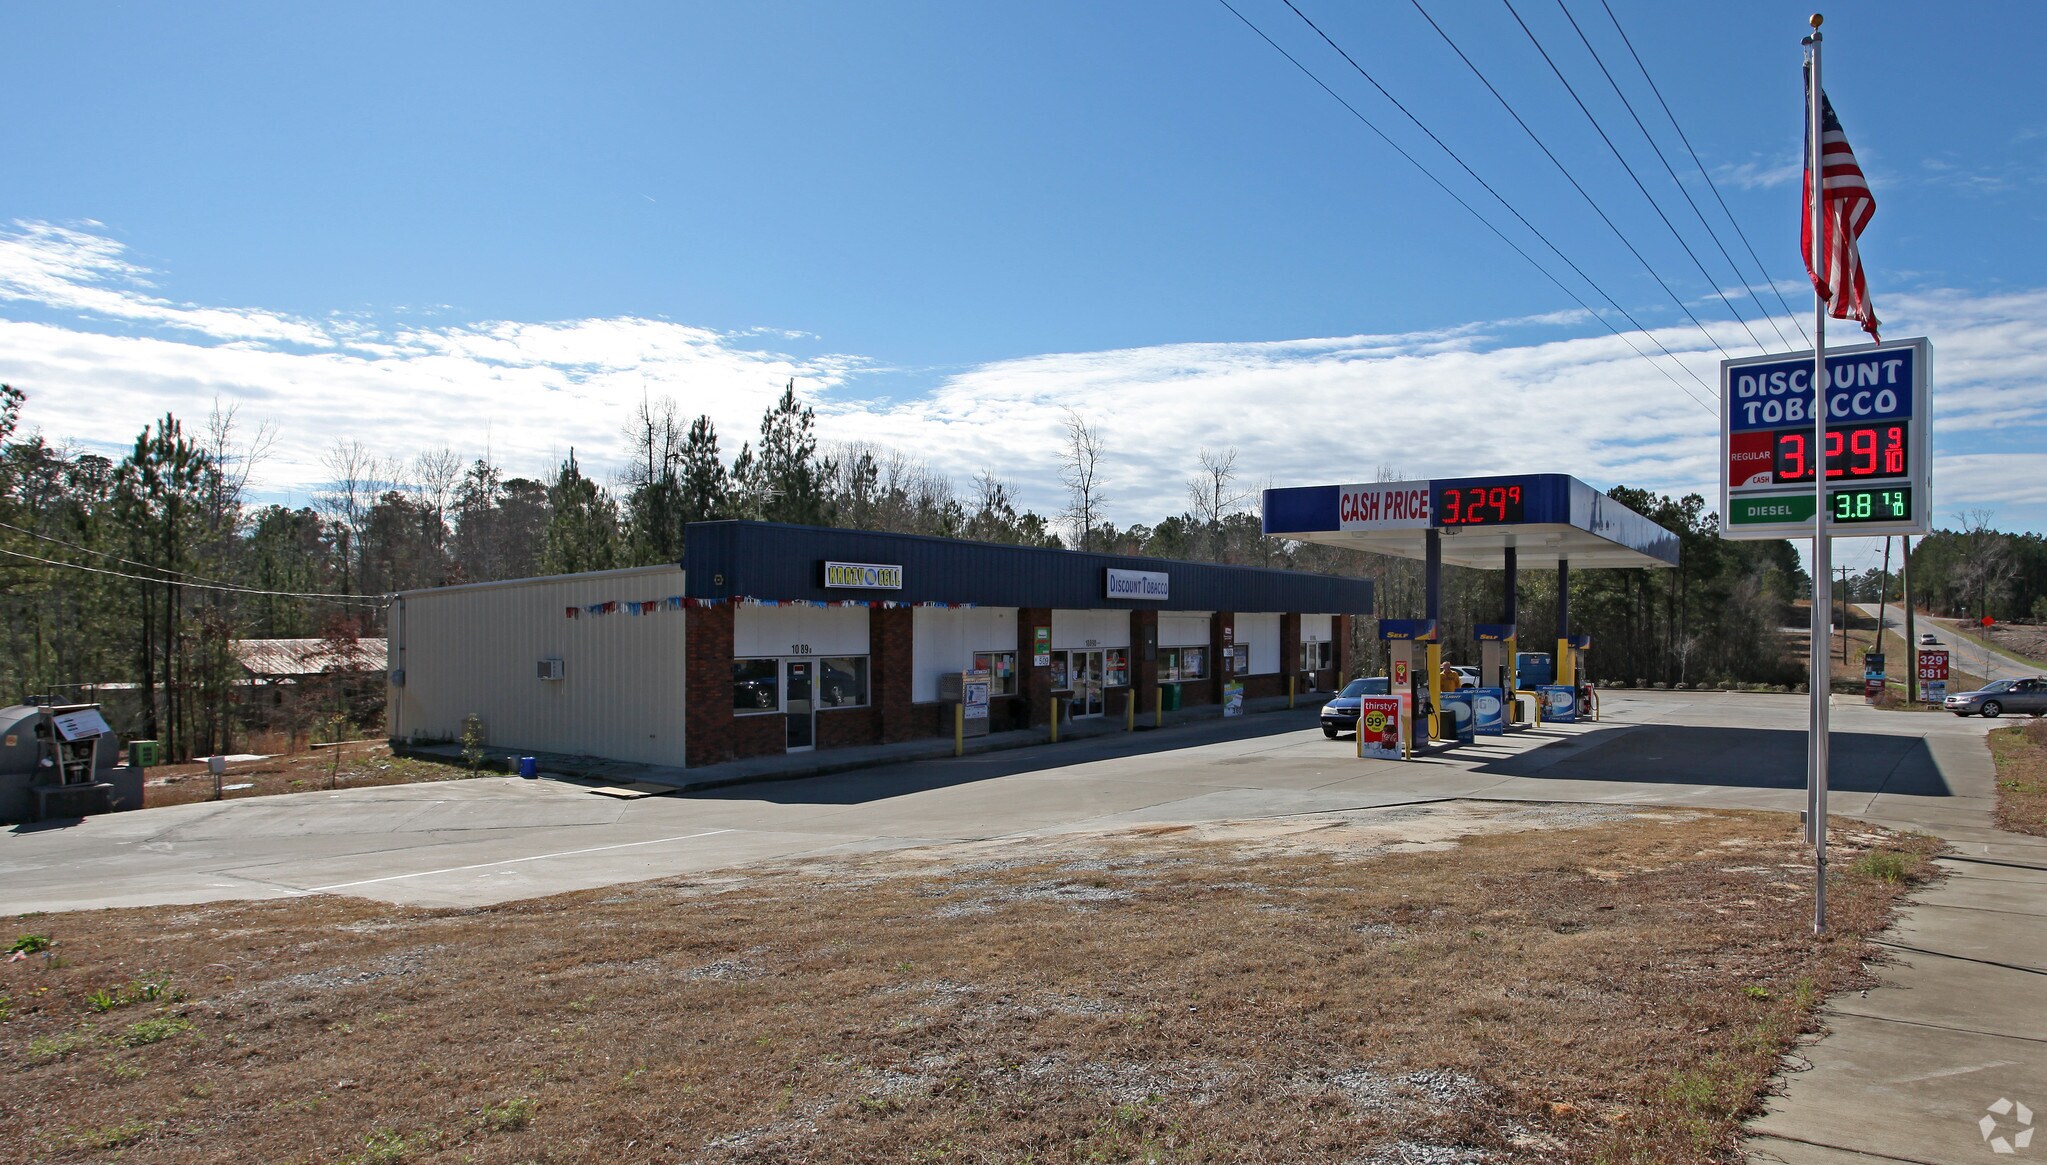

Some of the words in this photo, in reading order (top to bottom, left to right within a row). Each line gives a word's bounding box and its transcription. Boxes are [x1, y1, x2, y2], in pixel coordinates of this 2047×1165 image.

[1738, 359, 1903, 398] DISCOUNT
[1731, 451, 1771, 461] REGULAR
[1752, 476, 1770, 484] CASH
[1340, 492, 1380, 523] CASH
[1383, 489, 1429, 520] PRICE
[1747, 505, 1792, 517] DIESEL
[828, 565, 865, 585] KRAZY
[877, 568, 901, 586] CELL
[1364, 702, 1398, 712] thirsty?
